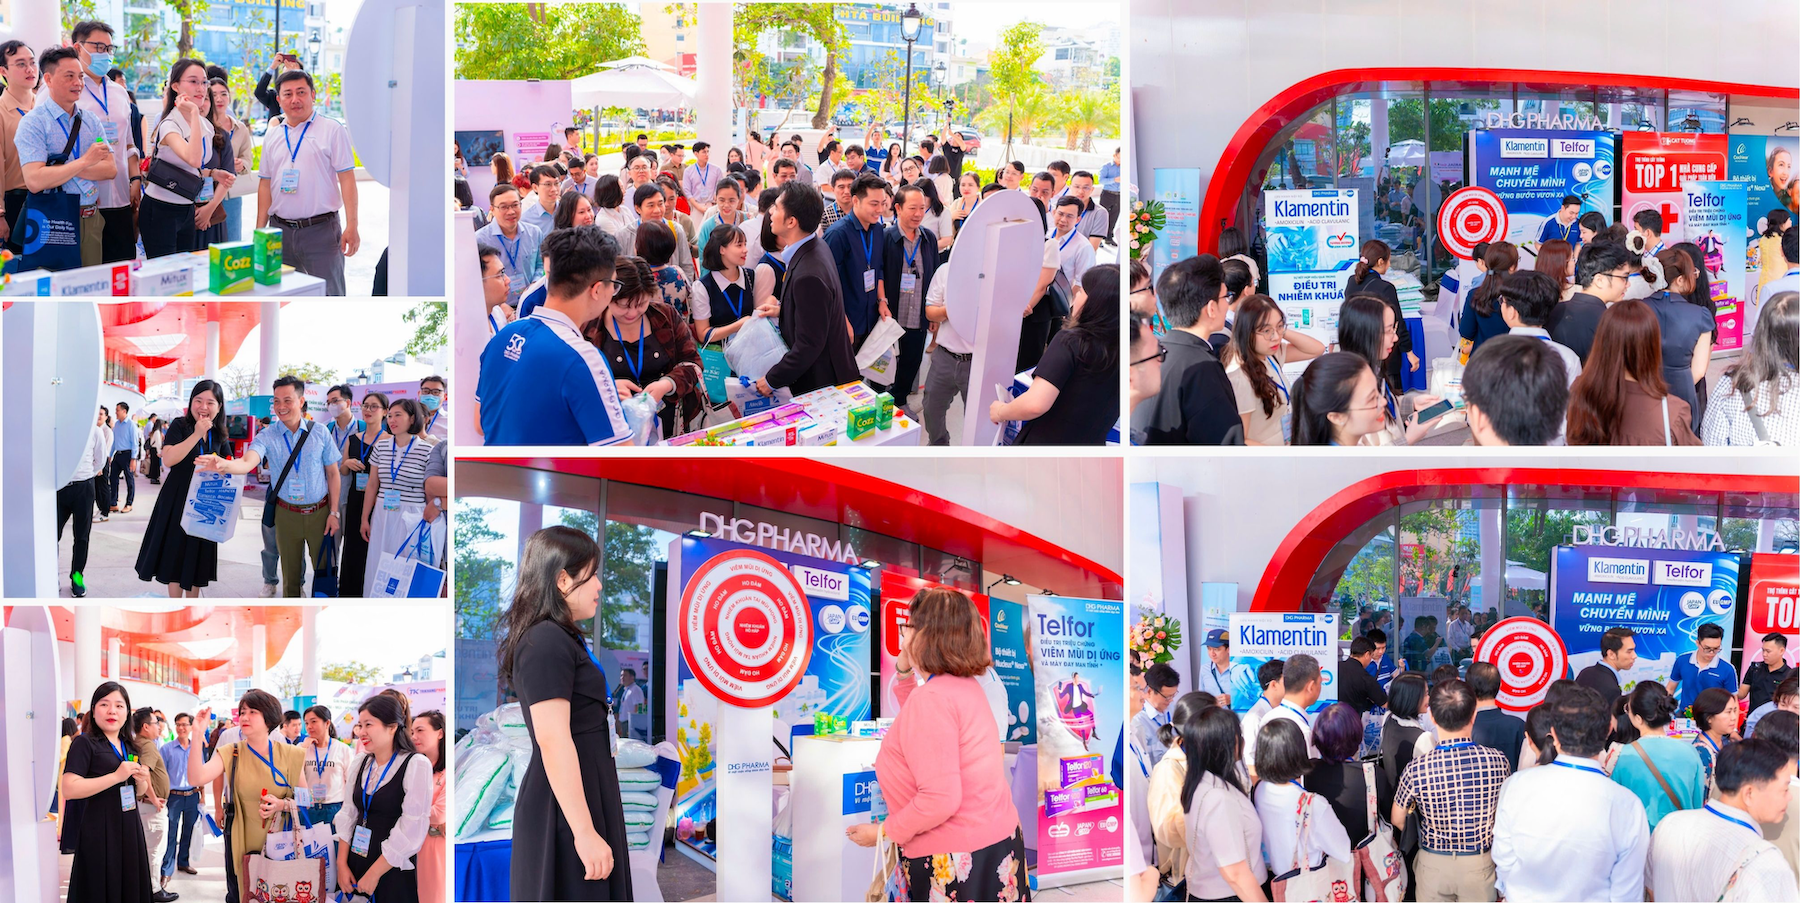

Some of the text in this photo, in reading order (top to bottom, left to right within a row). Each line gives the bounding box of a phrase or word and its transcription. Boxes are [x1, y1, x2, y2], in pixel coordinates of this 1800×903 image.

[1488, 112, 1605, 131] DHG PHARMA
[1505, 141, 1590, 152] Klamentin Telfor
[1490, 164, 1540, 178] MẠNH MẼ
[1635, 164, 1677, 188] TOP 1
[1496, 175, 1567, 188] CHUYỂN MÌNH
[1555, 191, 1565, 199] XA
[1687, 193, 1726, 207] Telfor
[1275, 199, 1350, 218] Klamentin
[224, 254, 251, 271] Cozz
[61, 281, 110, 296] Klamentin
[1293, 279, 1337, 292] ĐIỀU TRỊ
[1278, 289, 1344, 301] NHIỄM KHUẨ
[856, 417, 874, 428] Cozz
[757, 435, 785, 446] Klamentin
[700, 511, 860, 566] DHG PHARMA
[1572, 525, 1726, 552] DHG PHARMA
[730, 564, 744, 572] VIÊM
[761, 565, 773, 577] ỨNG
[1594, 560, 1704, 580] Klamentin Telfor
[804, 570, 842, 592] Telfor
[691, 614, 699, 633] VIÊM
[700, 580, 712, 594] ỨNG
[713, 602, 721, 612] HO
[776, 597, 785, 607] HO
[1572, 592, 1637, 609] MẠNH MẼ
[1096, 605, 1120, 614] PHARMA
[1580, 604, 1670, 621] CHUYỂN MÌNH
[1037, 613, 1095, 638] Telfor
[1579, 624, 1607, 634] VỮNG
[1656, 627, 1667, 635] XA
[1240, 625, 1328, 647] Klamentin
[713, 644, 723, 656] HO
[1040, 646, 1121, 662] VIÊM MŨI DỊ ỨNG
[1066, 762, 1083, 772] Telfor
[1050, 793, 1070, 803] Telfor
[1087, 787, 1101, 796] Telfor
